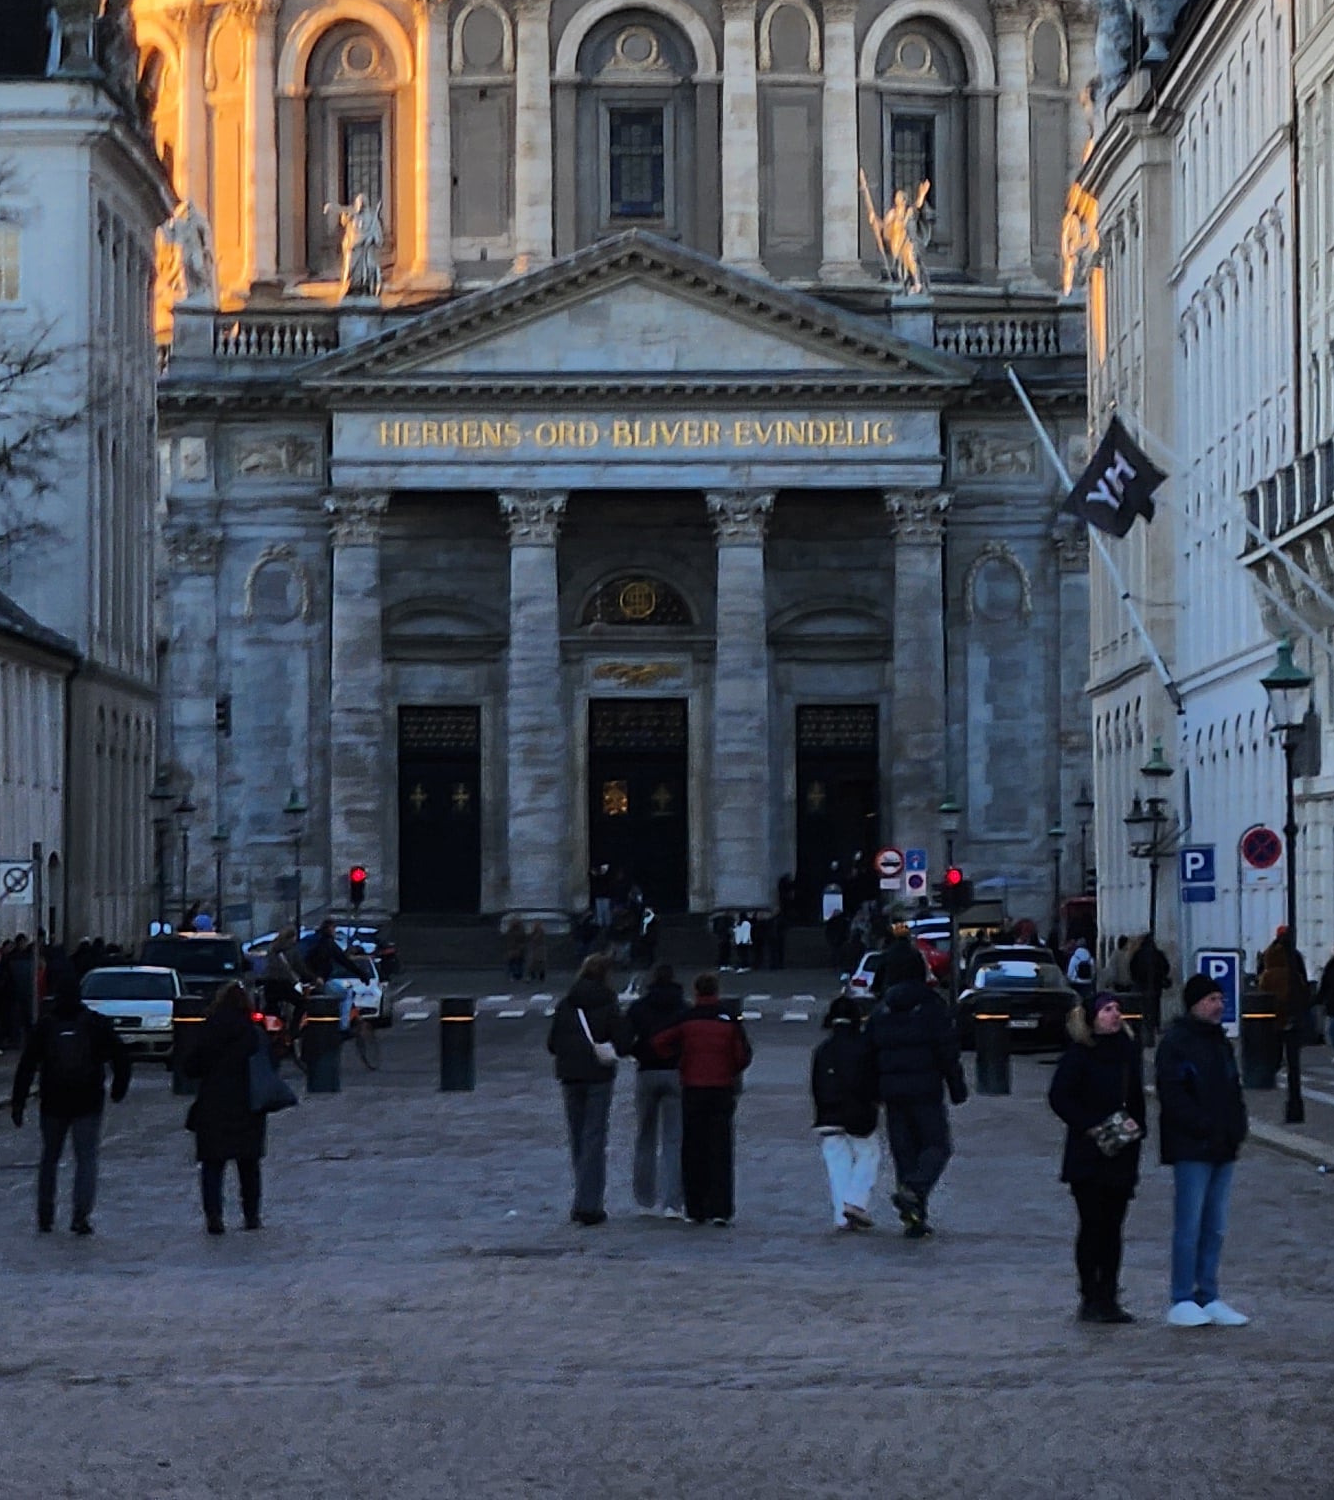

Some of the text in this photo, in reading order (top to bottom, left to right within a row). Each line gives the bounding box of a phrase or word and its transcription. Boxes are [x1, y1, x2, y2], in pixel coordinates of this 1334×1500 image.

[380, 419, 894, 448] HERRENS ORD BLIVER EVINDELIG
[1185, 852, 1205, 879] P
[1209, 959, 1228, 980] P
